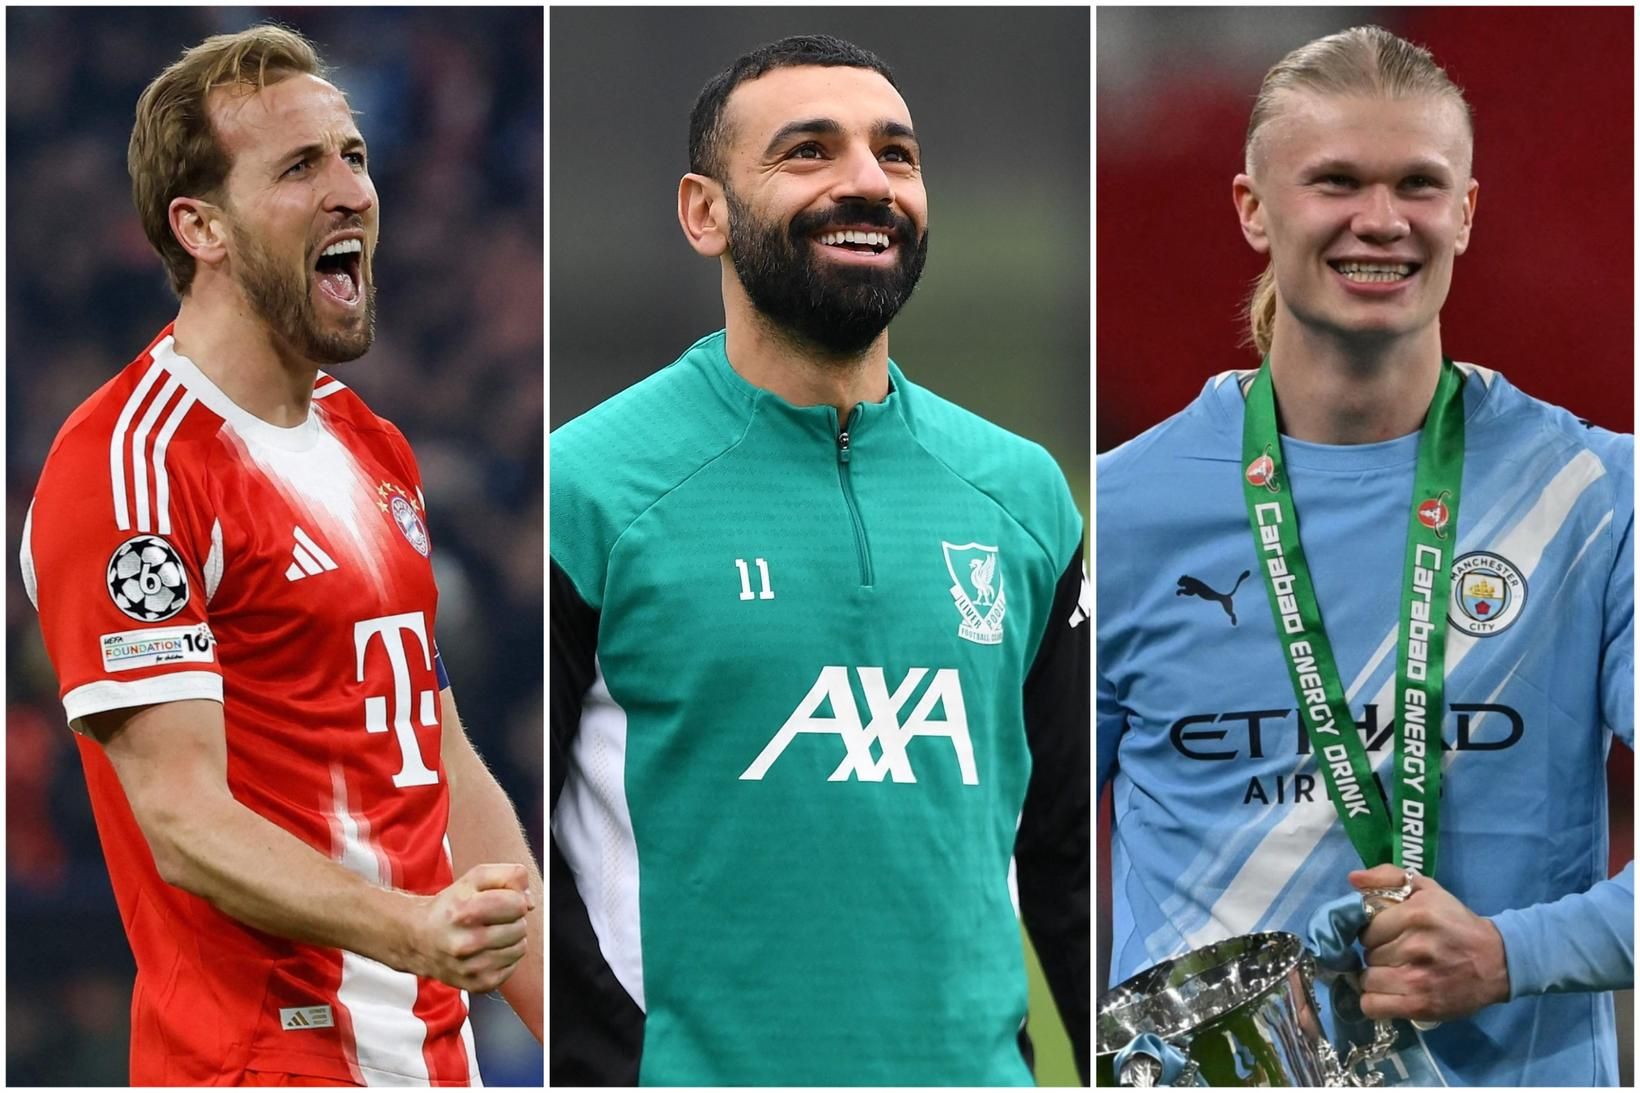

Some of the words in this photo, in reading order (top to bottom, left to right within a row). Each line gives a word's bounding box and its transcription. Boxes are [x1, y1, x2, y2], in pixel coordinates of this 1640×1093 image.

[140, 562, 161, 595] 6
[735, 558, 775, 601] 11
[1450, 557, 1519, 587] MANCHESTER
[1407, 543, 1442, 681] Carabao
[1469, 623, 1495, 631] CITY
[105, 639, 183, 658] FOUNDATION
[1255, 502, 1305, 634] Carabao
[1289, 640, 1340, 736] ENERGY
[1323, 743, 1371, 818] DRINK
[738, 665, 980, 786] AXA
[1403, 687, 1426, 794] ENERGY
